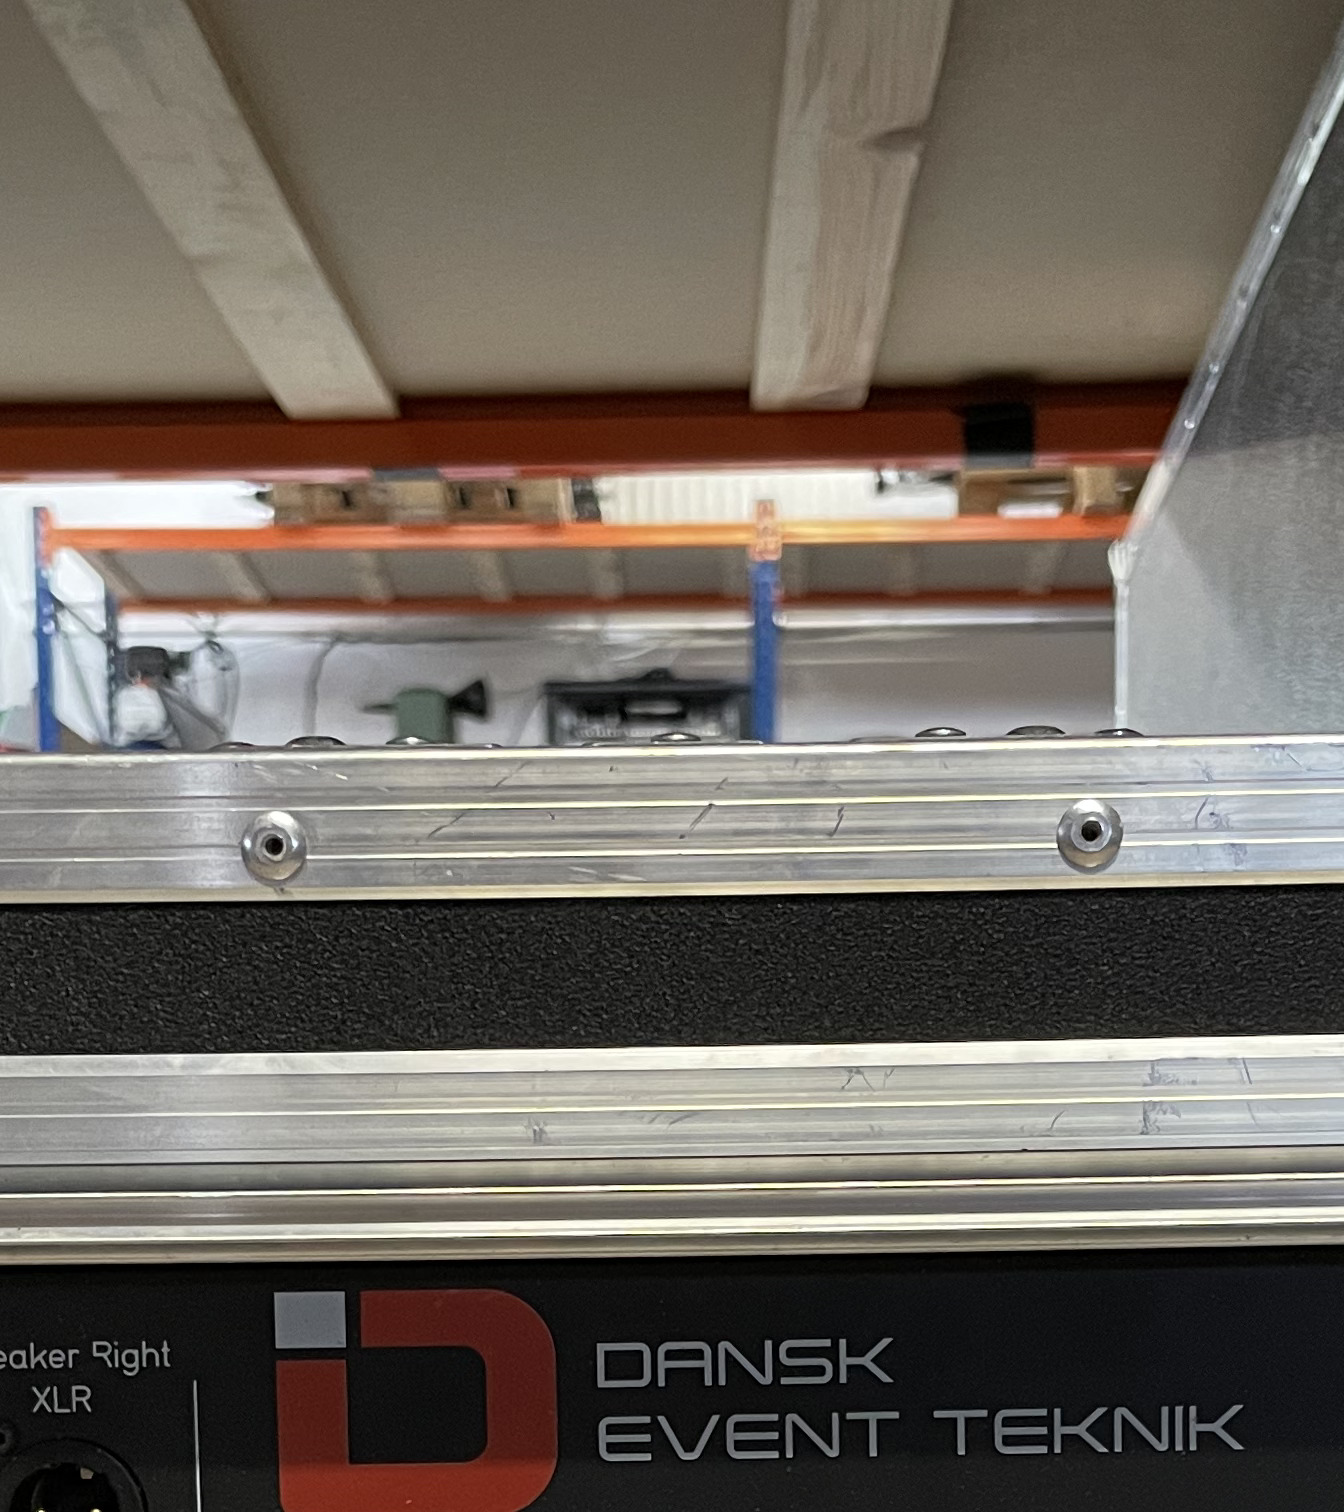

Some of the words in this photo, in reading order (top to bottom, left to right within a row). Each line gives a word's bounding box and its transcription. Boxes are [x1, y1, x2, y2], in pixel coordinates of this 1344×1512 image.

[92, 1340, 171, 1377] Right
[596, 1337, 894, 1388] DANSK
[31, 1384, 92, 1414] XLR
[598, 1411, 900, 1462] EVENT
[933, 1404, 1245, 1456] TEKNIK
